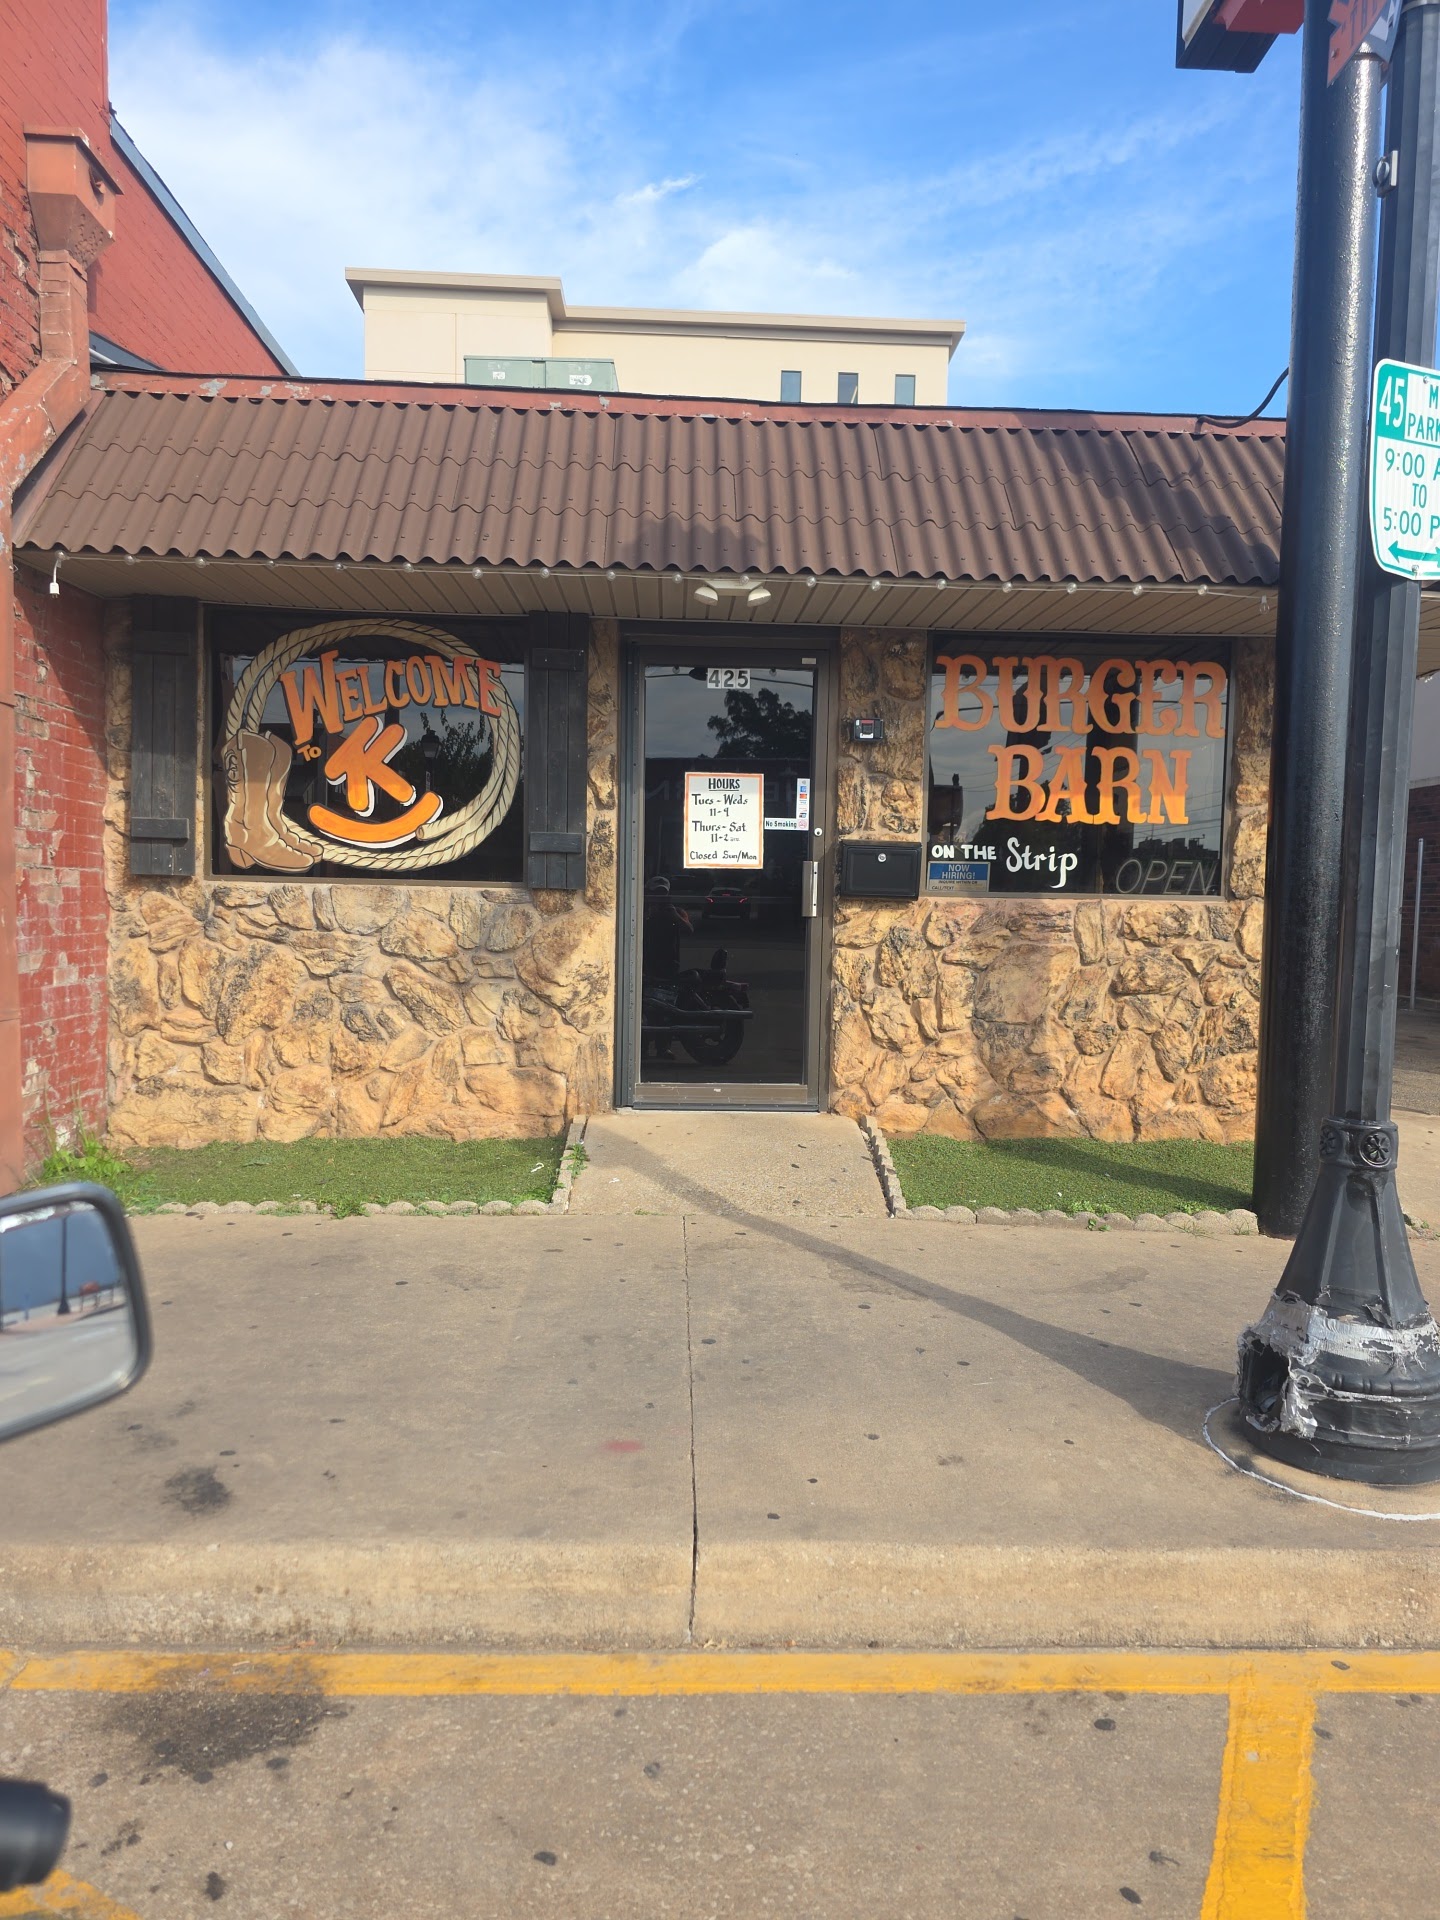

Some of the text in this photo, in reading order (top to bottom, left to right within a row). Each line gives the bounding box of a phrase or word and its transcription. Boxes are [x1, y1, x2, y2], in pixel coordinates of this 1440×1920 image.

[1379, 375, 1439, 428] 45 M
[1407, 412, 1440, 442] PARK
[1385, 447, 1440, 481] 9:00 A
[1412, 482, 1427, 508] TO
[1383, 507, 1440, 539] 5:00 P
[708, 669, 749, 688] 425
[278, 649, 501, 745] WELCOME
[934, 654, 1227, 738] BURGER
[297, 744, 322, 762] TO
[324, 715, 417, 818] K
[708, 778, 740, 791] HOURS
[985, 744, 1191, 825] BARN
[691, 793, 714, 806] Tues
[723, 794, 749, 806] Weds
[709, 807, 730, 817] 11-9
[729, 821, 747, 833] Sat
[765, 820, 797, 829] No Smoking
[710, 833, 728, 843] 11-2
[689, 850, 757, 863] Closed Sun/Mon
[931, 836, 1078, 889] ON THE Strip
[941, 872, 976, 880] HIRING!
[1115, 858, 1217, 896] OPEN
